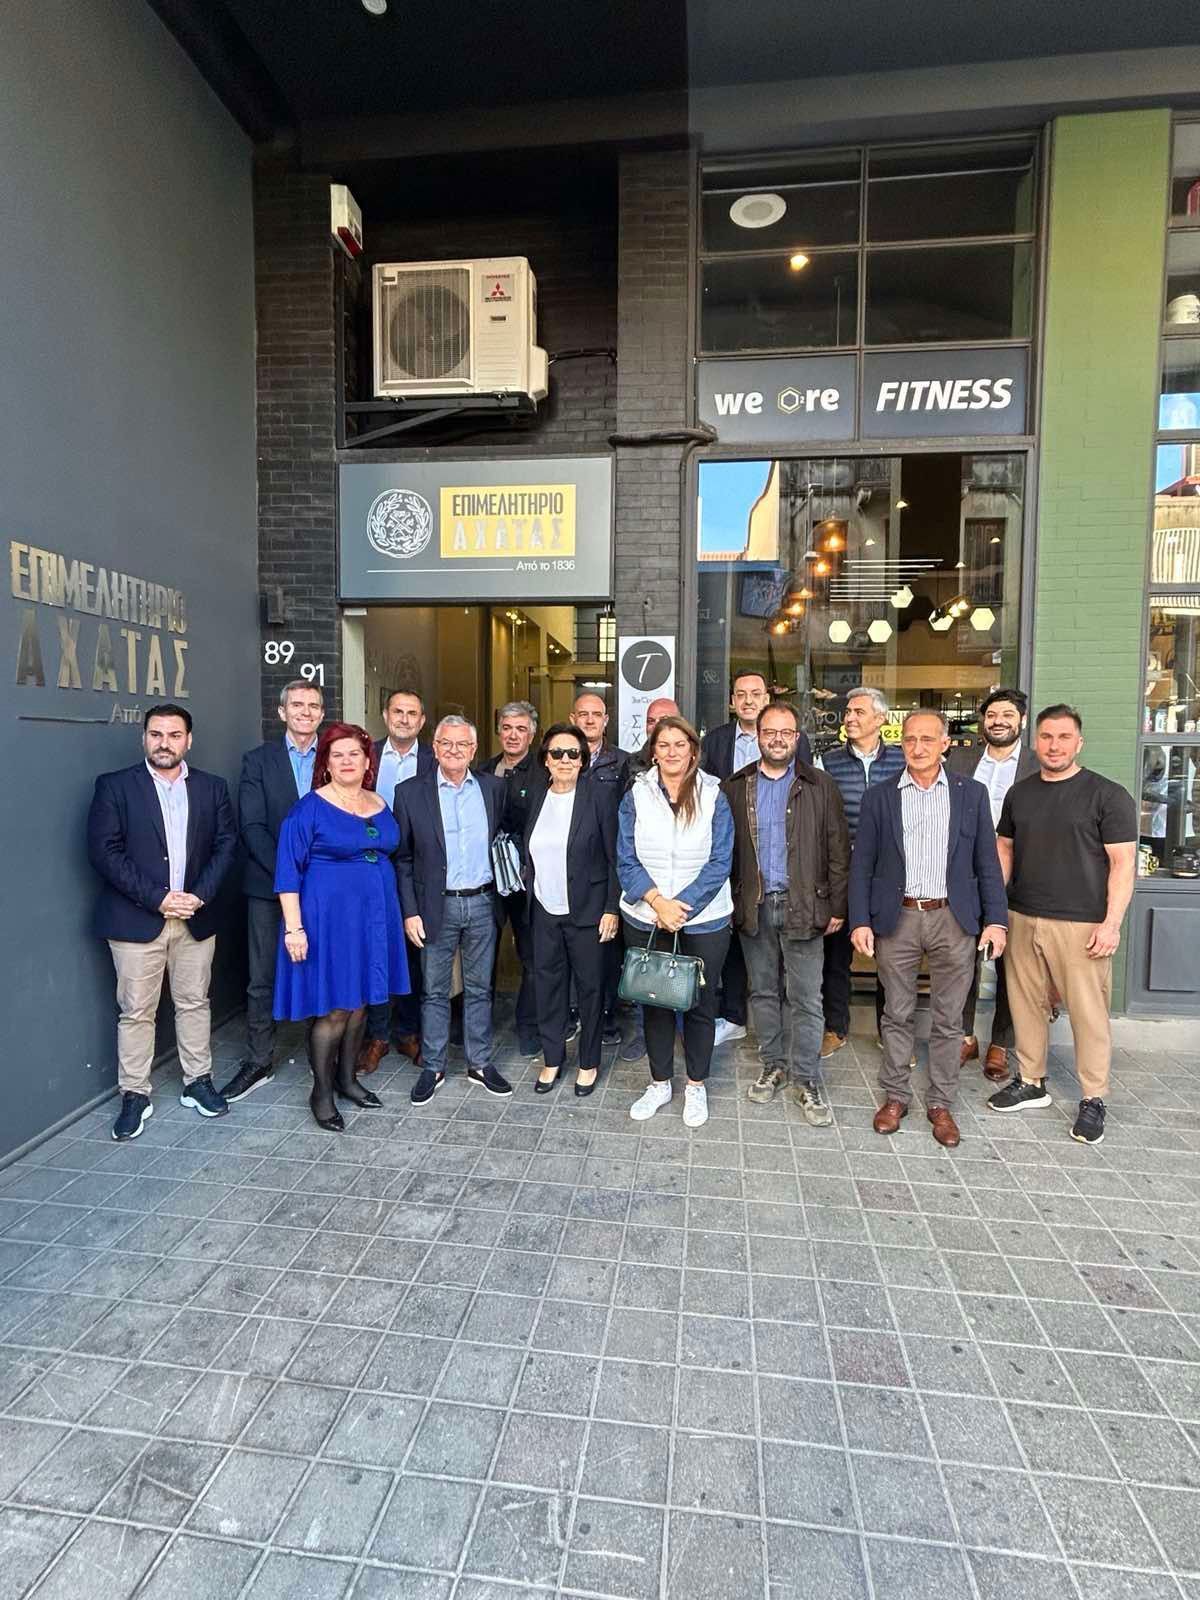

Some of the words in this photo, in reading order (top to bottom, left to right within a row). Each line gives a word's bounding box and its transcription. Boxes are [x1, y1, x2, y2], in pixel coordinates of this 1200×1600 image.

[714, 391, 763, 415] we
[876, 378, 1013, 411] FITNESS
[452, 492, 564, 517] ΕΠΙΜΕΛΗΤΗΡΙΟ
[516, 560, 538, 571] Από
[552, 560, 575, 570] 1836
[10, 541, 188, 635] ΕΠΙΜΕΛΗΤΗΡΙΟ
[264, 641, 295, 664] 89
[300, 663, 324, 687] 91
